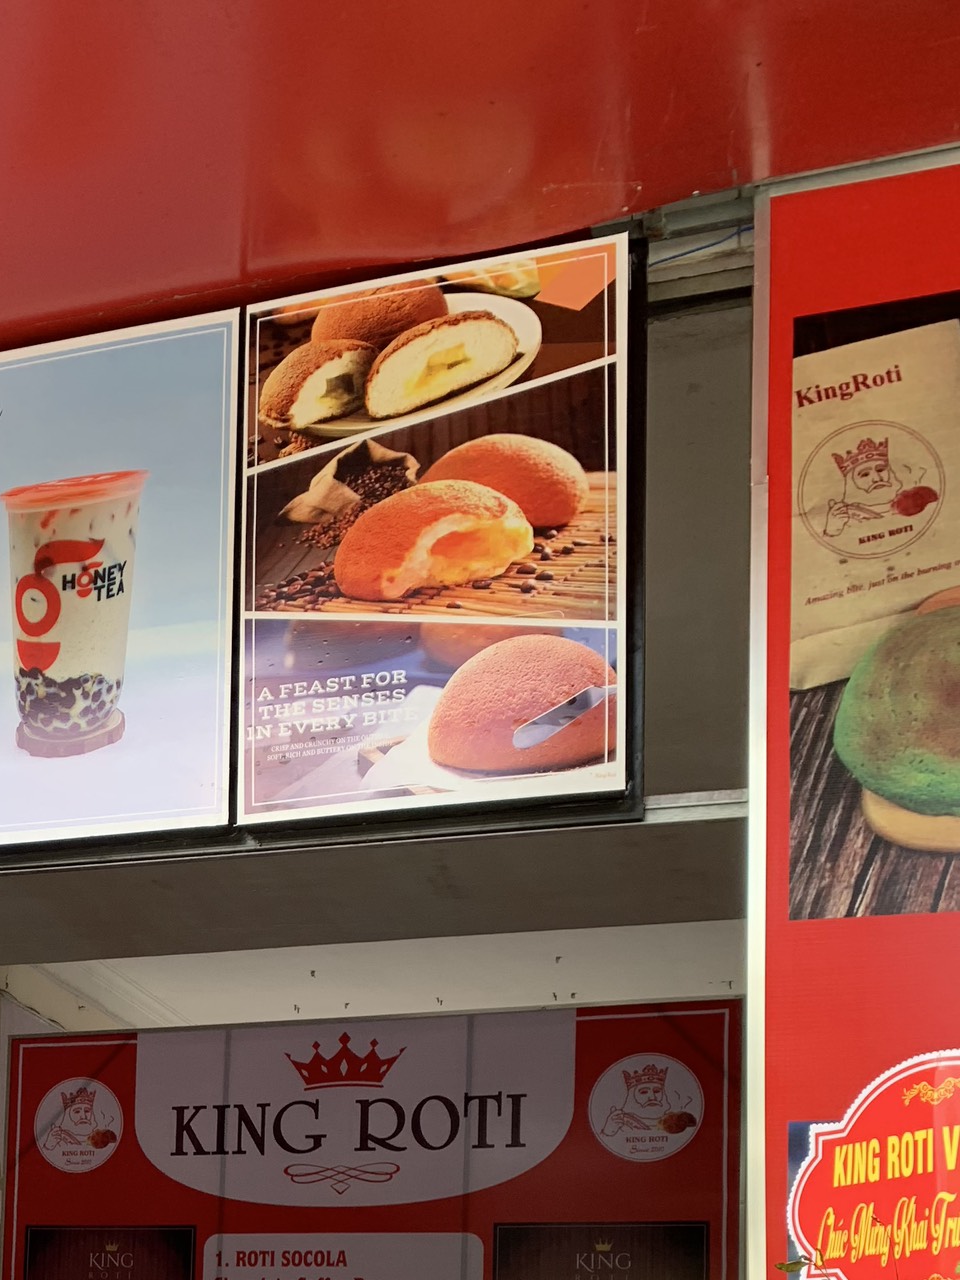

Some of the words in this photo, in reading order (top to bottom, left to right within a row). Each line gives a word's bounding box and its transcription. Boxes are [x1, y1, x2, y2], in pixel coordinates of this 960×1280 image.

[794, 365, 902, 408] KingRoti
[859, 532, 885, 545] KING
[888, 525, 913, 537] ROTI
[62, 560, 127, 597] HONEY
[94, 579, 124, 602] TEA
[257, 687, 274, 702] A
[279, 676, 356, 699] FEAST
[361, 670, 408, 688] FOR
[259, 701, 306, 720] THE
[312, 689, 406, 713] SENSES
[246, 724, 273, 740] IN
[278, 714, 357, 736] EVERY
[362, 707, 419, 727] BITE
[290, 742, 304, 750] AND
[170, 1098, 328, 1156] KING
[354, 1091, 528, 1152] ROTI
[833, 1138, 881, 1188] KING
[887, 1128, 934, 1179] ROTI
[894, 1196, 929, 1260] Khai
[89, 1252, 134, 1271] KING
[216, 1250, 229, 1267] 1.
[236, 1250, 275, 1267] ROTI
[281, 1250, 348, 1267] SOCOLA
[575, 1253, 632, 1273] KING
